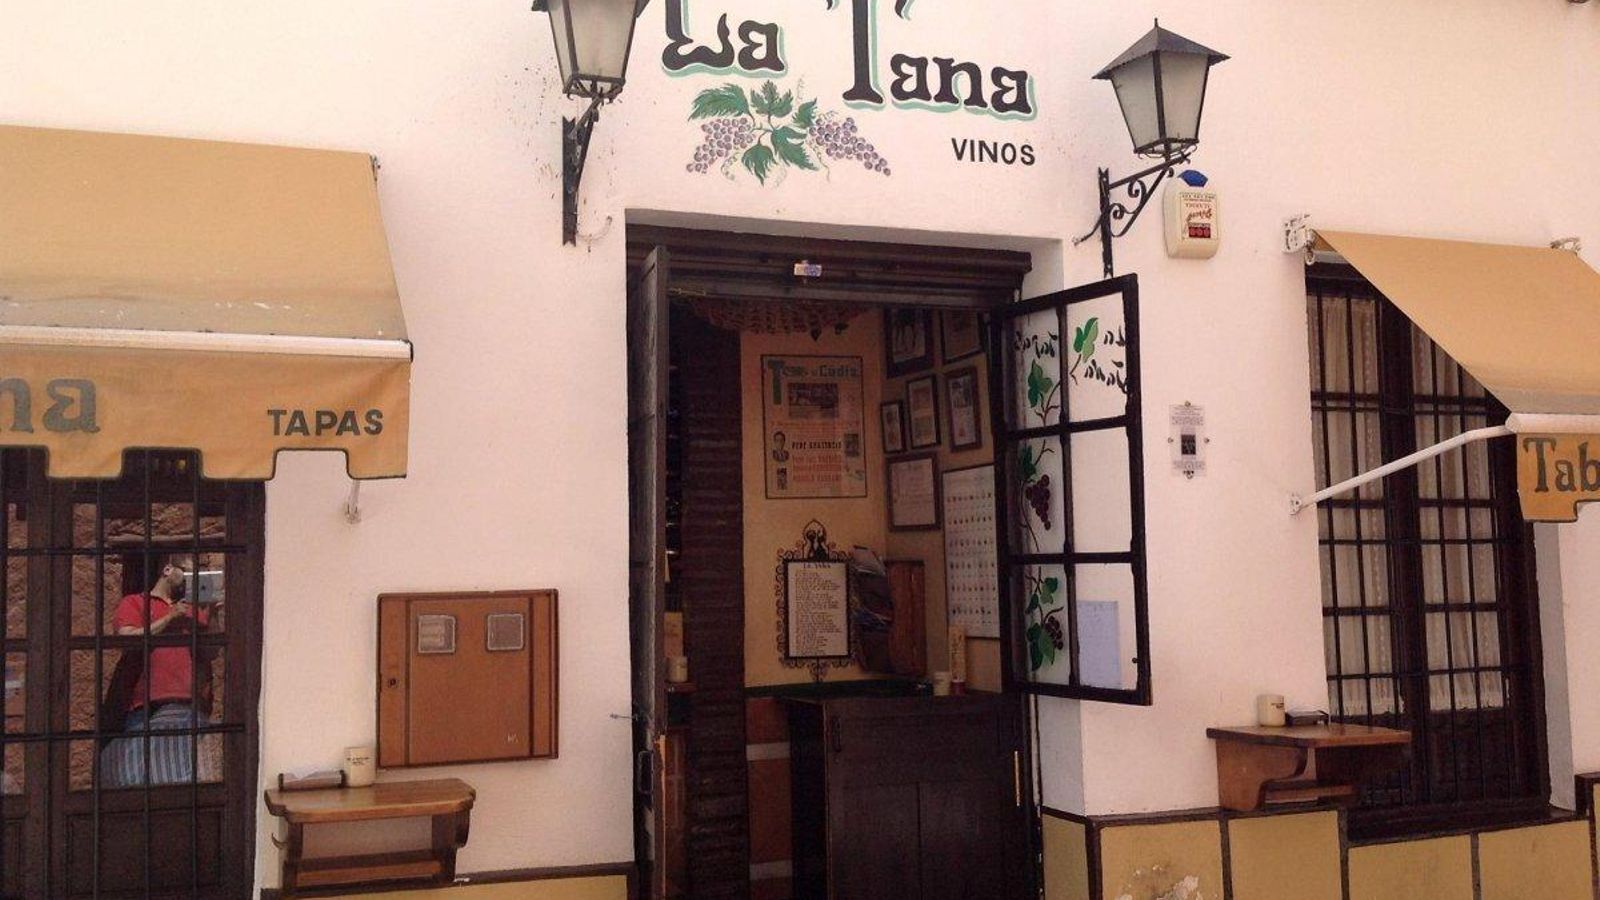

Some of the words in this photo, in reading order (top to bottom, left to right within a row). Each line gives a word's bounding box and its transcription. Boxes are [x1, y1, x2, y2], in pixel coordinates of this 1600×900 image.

[662, 0, 786, 76] La
[826, 0, 1035, 119] Tana
[951, 137, 1036, 167] VINOS
[267, 408, 384, 437] TAPAS
[1522, 437, 1600, 493] Tab
